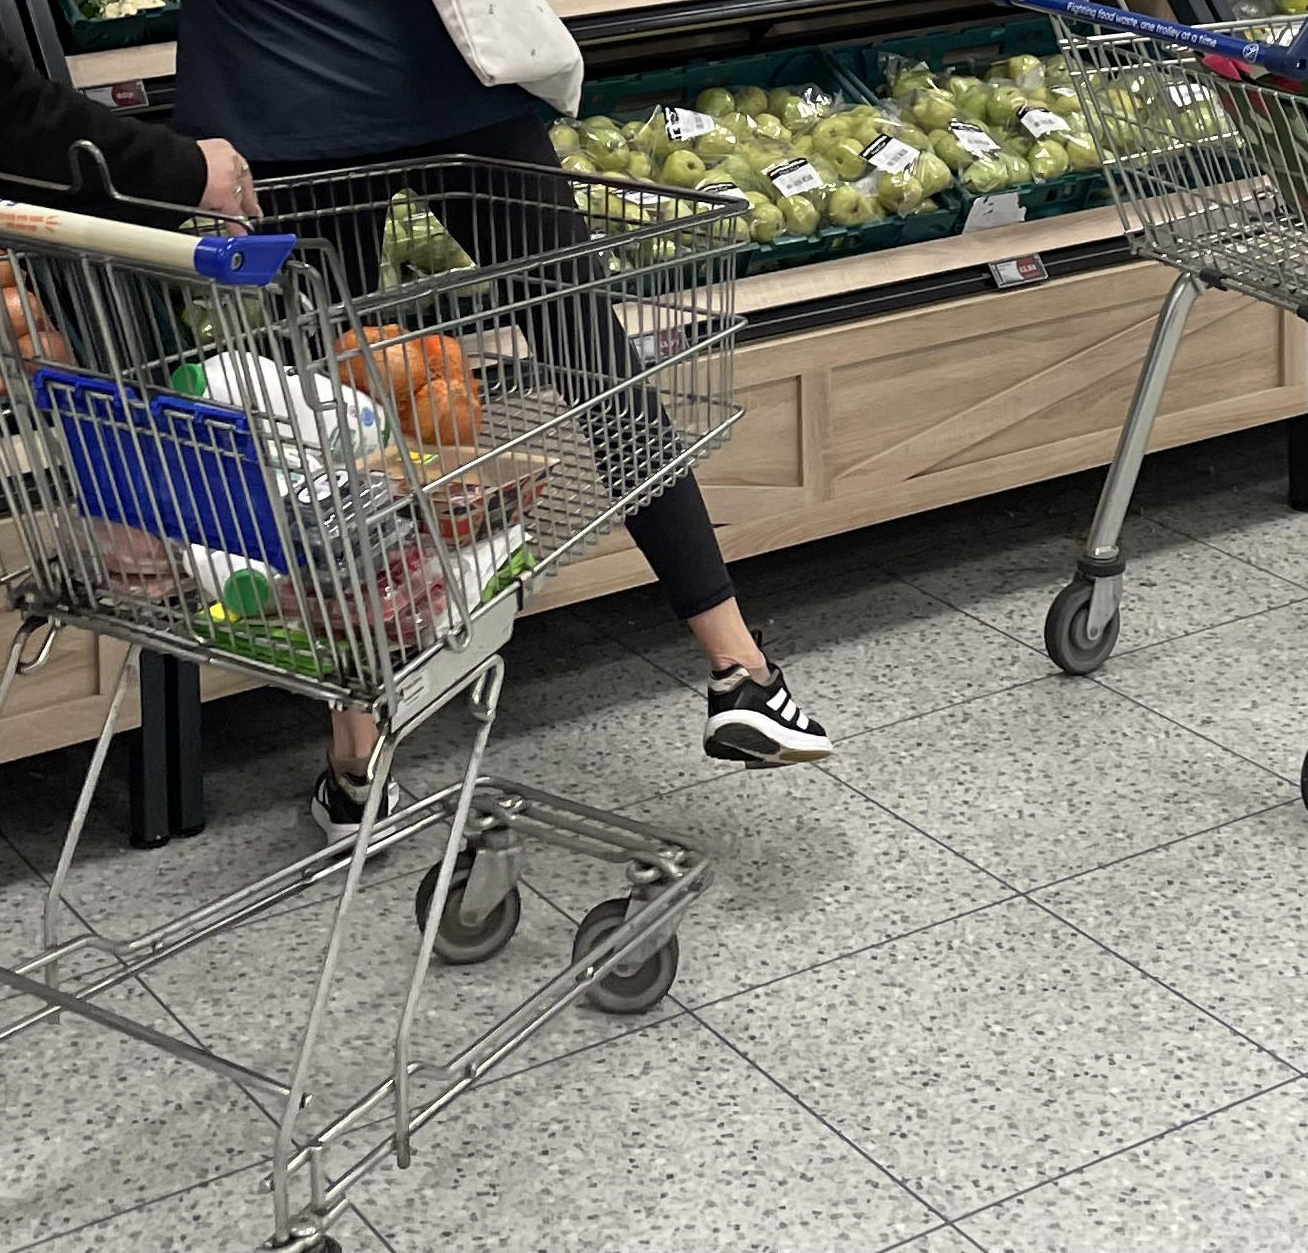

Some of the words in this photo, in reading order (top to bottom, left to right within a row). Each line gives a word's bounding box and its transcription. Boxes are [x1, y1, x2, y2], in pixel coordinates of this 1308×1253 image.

[1066, 1, 1097, 20] Fighting
[1097, 8, 1117, 22] food
[1140, 21, 1154, 33] one
[1156, 23, 1180, 40] trolley
[1181, 31, 1191, 41] at
[1191, 34, 1197, 43] a
[1198, 34, 1217, 48] time
